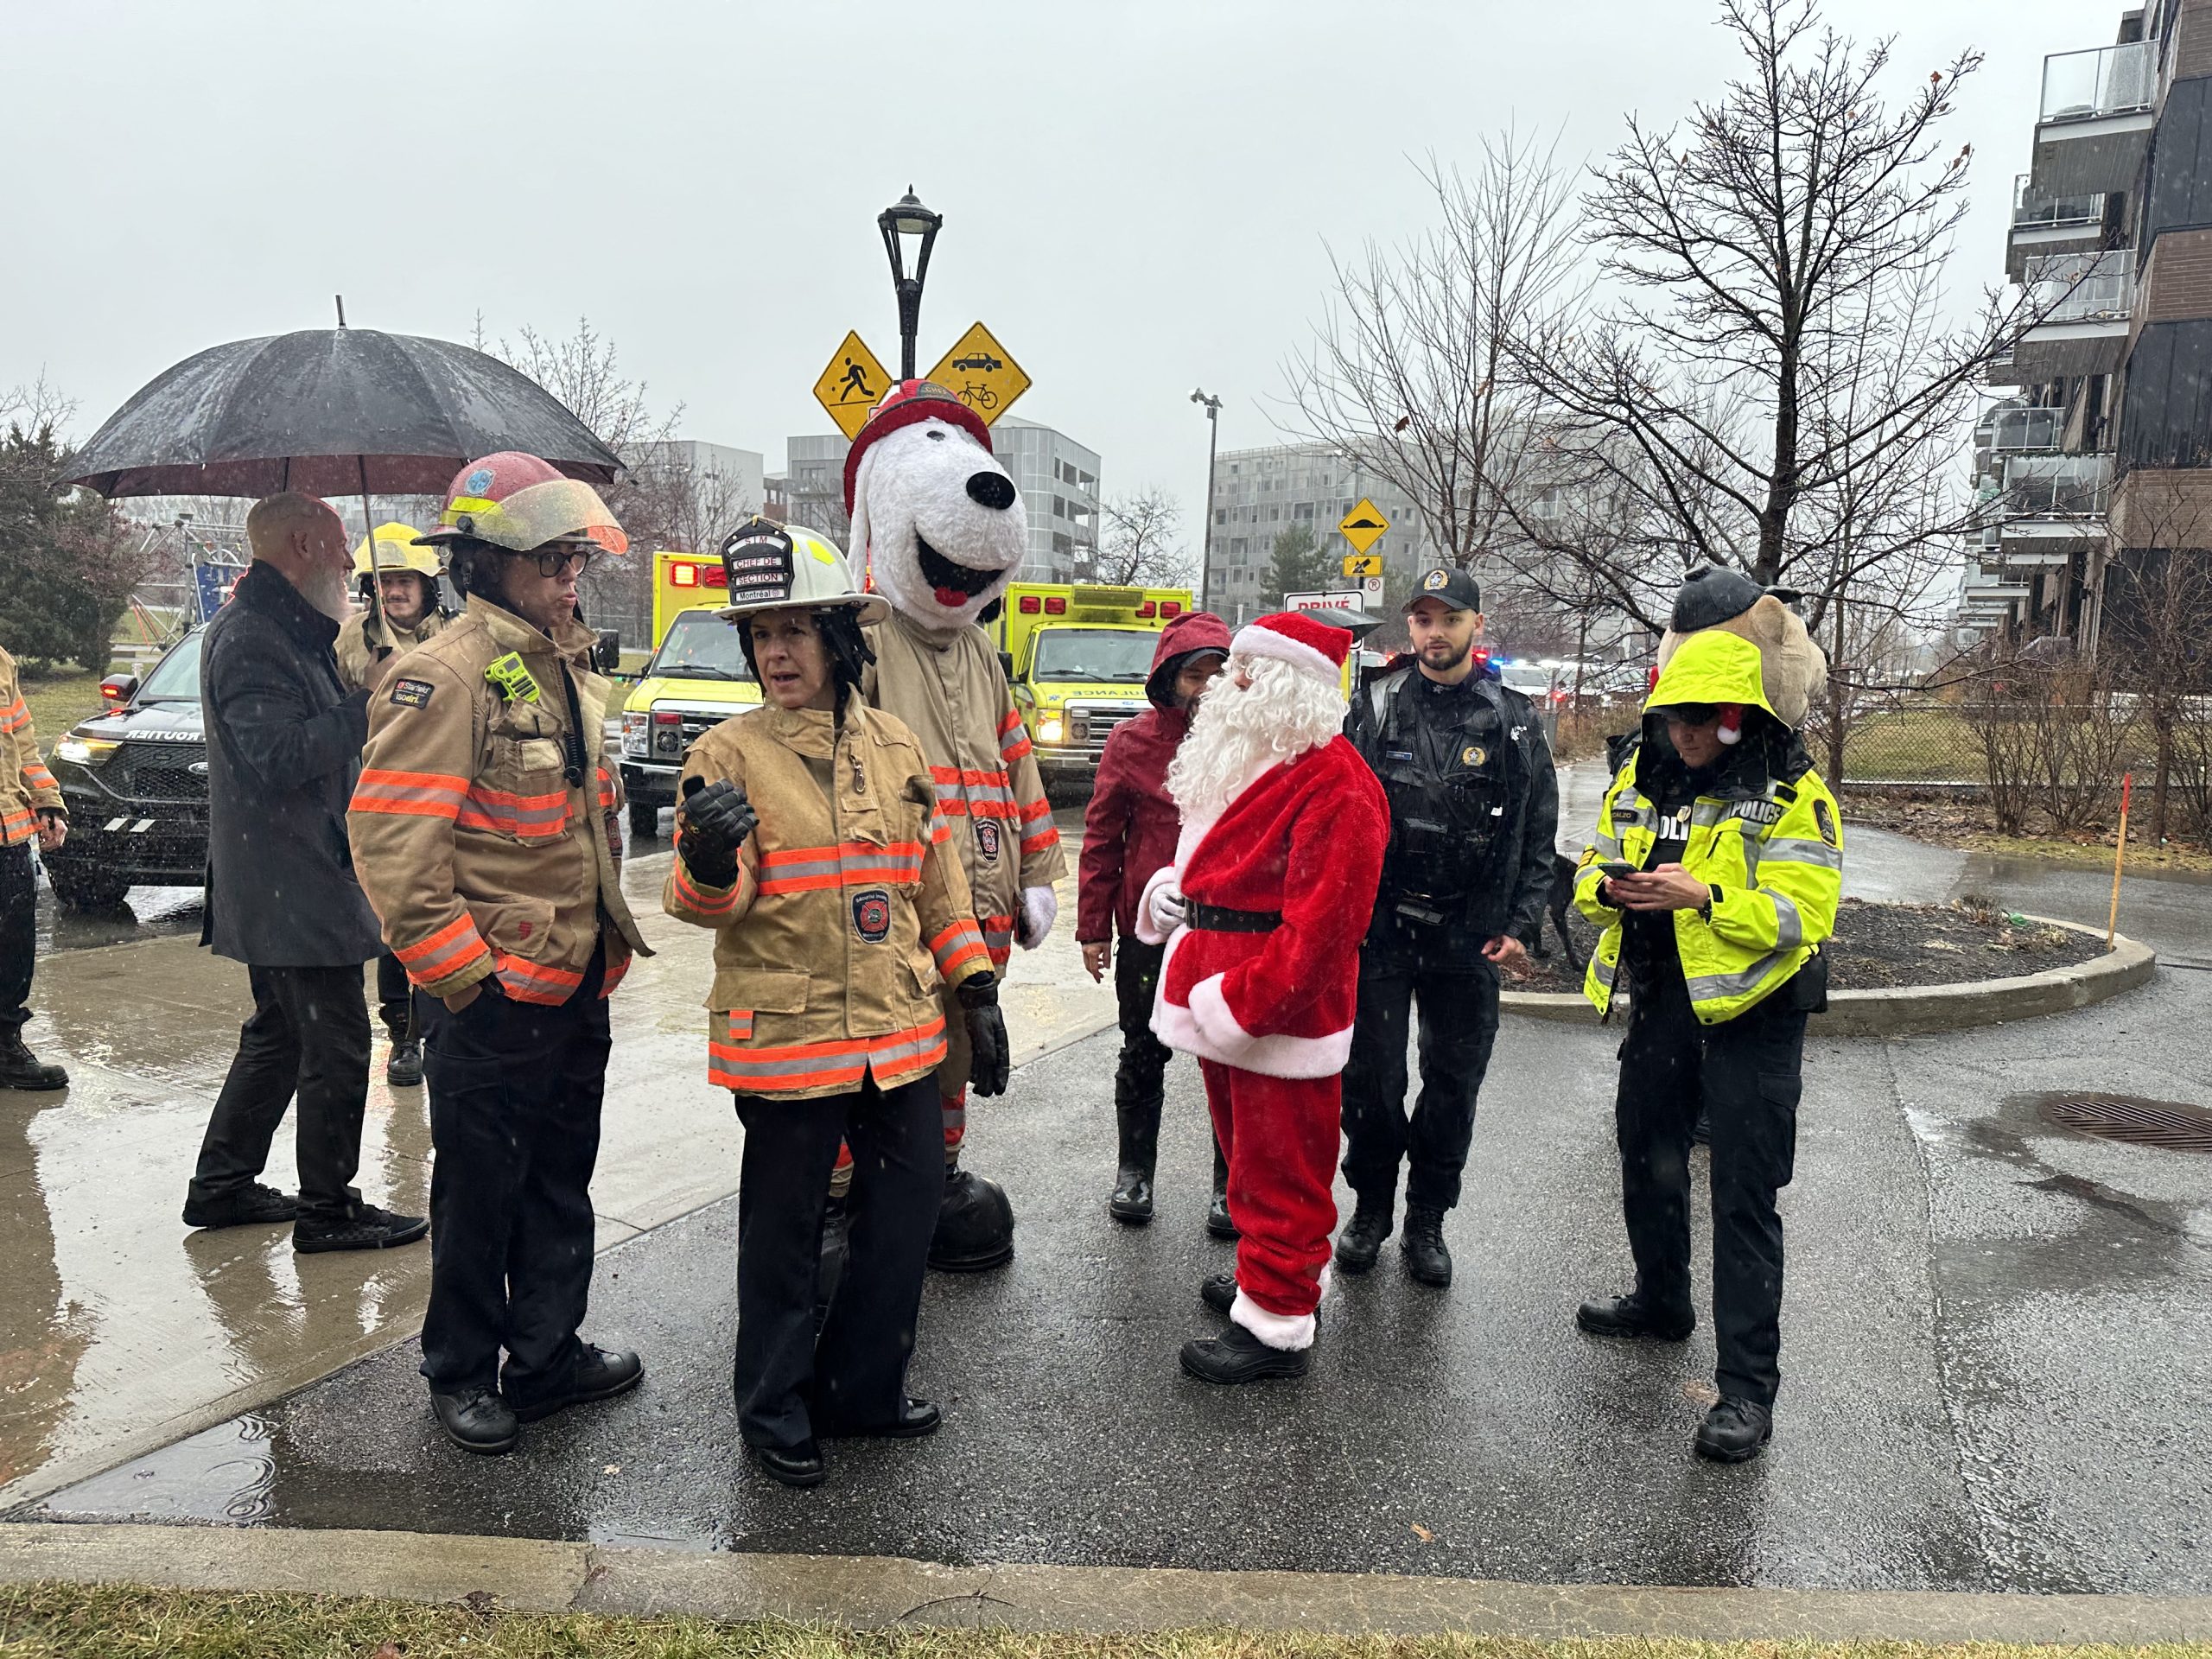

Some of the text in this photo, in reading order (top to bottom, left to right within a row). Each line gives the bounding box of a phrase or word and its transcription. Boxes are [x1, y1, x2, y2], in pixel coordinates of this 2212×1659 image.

[736, 558, 760, 569] CHEF
[739, 573, 778, 583] SECTION
[740, 589, 771, 600] Montréal
[1731, 799, 1780, 823] POLICE
[1659, 815, 1689, 841] OLI
